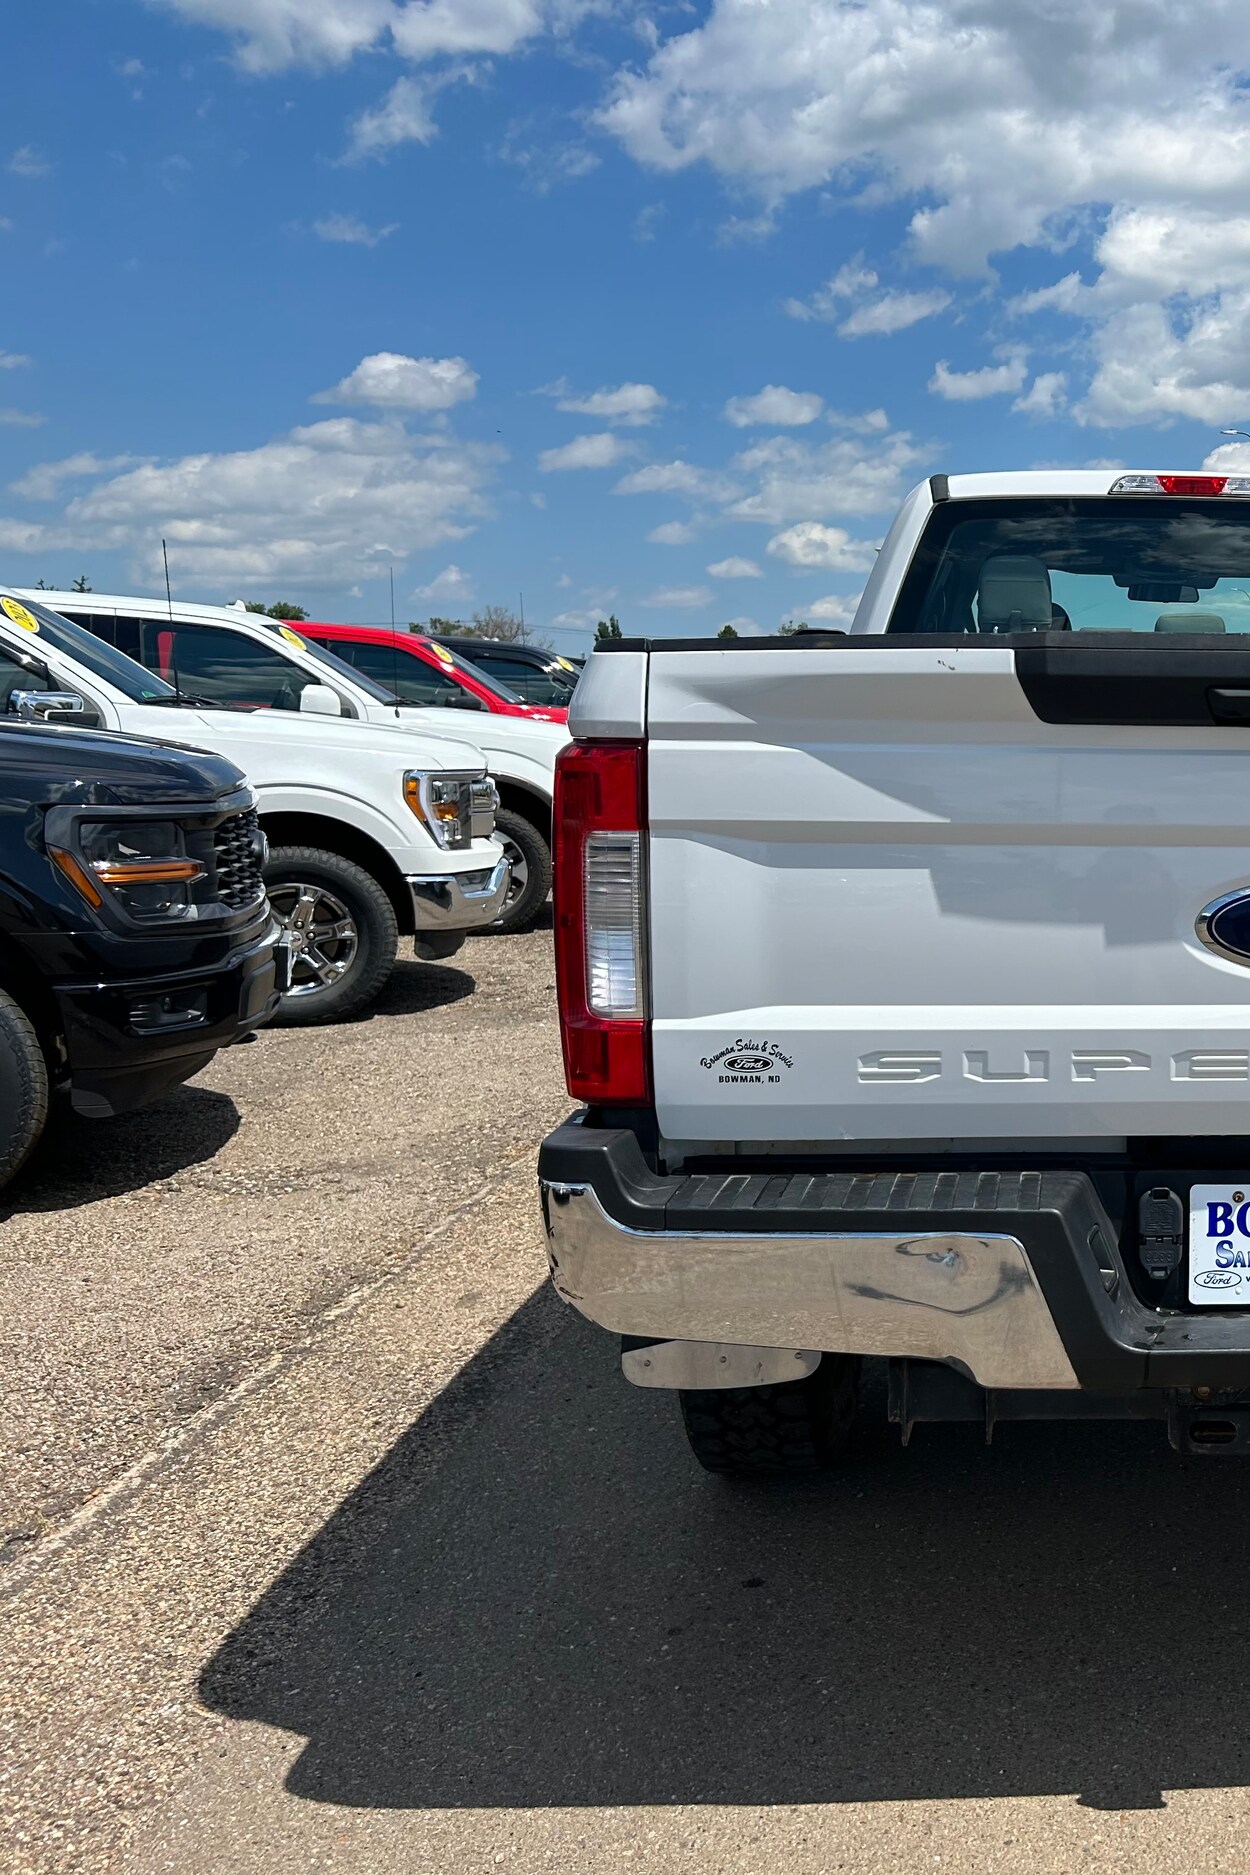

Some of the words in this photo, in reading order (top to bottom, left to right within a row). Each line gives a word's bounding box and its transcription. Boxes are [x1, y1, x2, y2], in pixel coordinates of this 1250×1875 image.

[700, 1045, 736, 1069] Bowman
[735, 1039, 760, 1052] Sales
[761, 1040, 769, 1052] &
[768, 1044, 795, 1069] Service
[734, 1057, 764, 1069] Ford
[718, 1075, 765, 1084] BOWMAN,
[768, 1075, 781, 1083] ND
[1203, 1272, 1233, 1286] Ford
